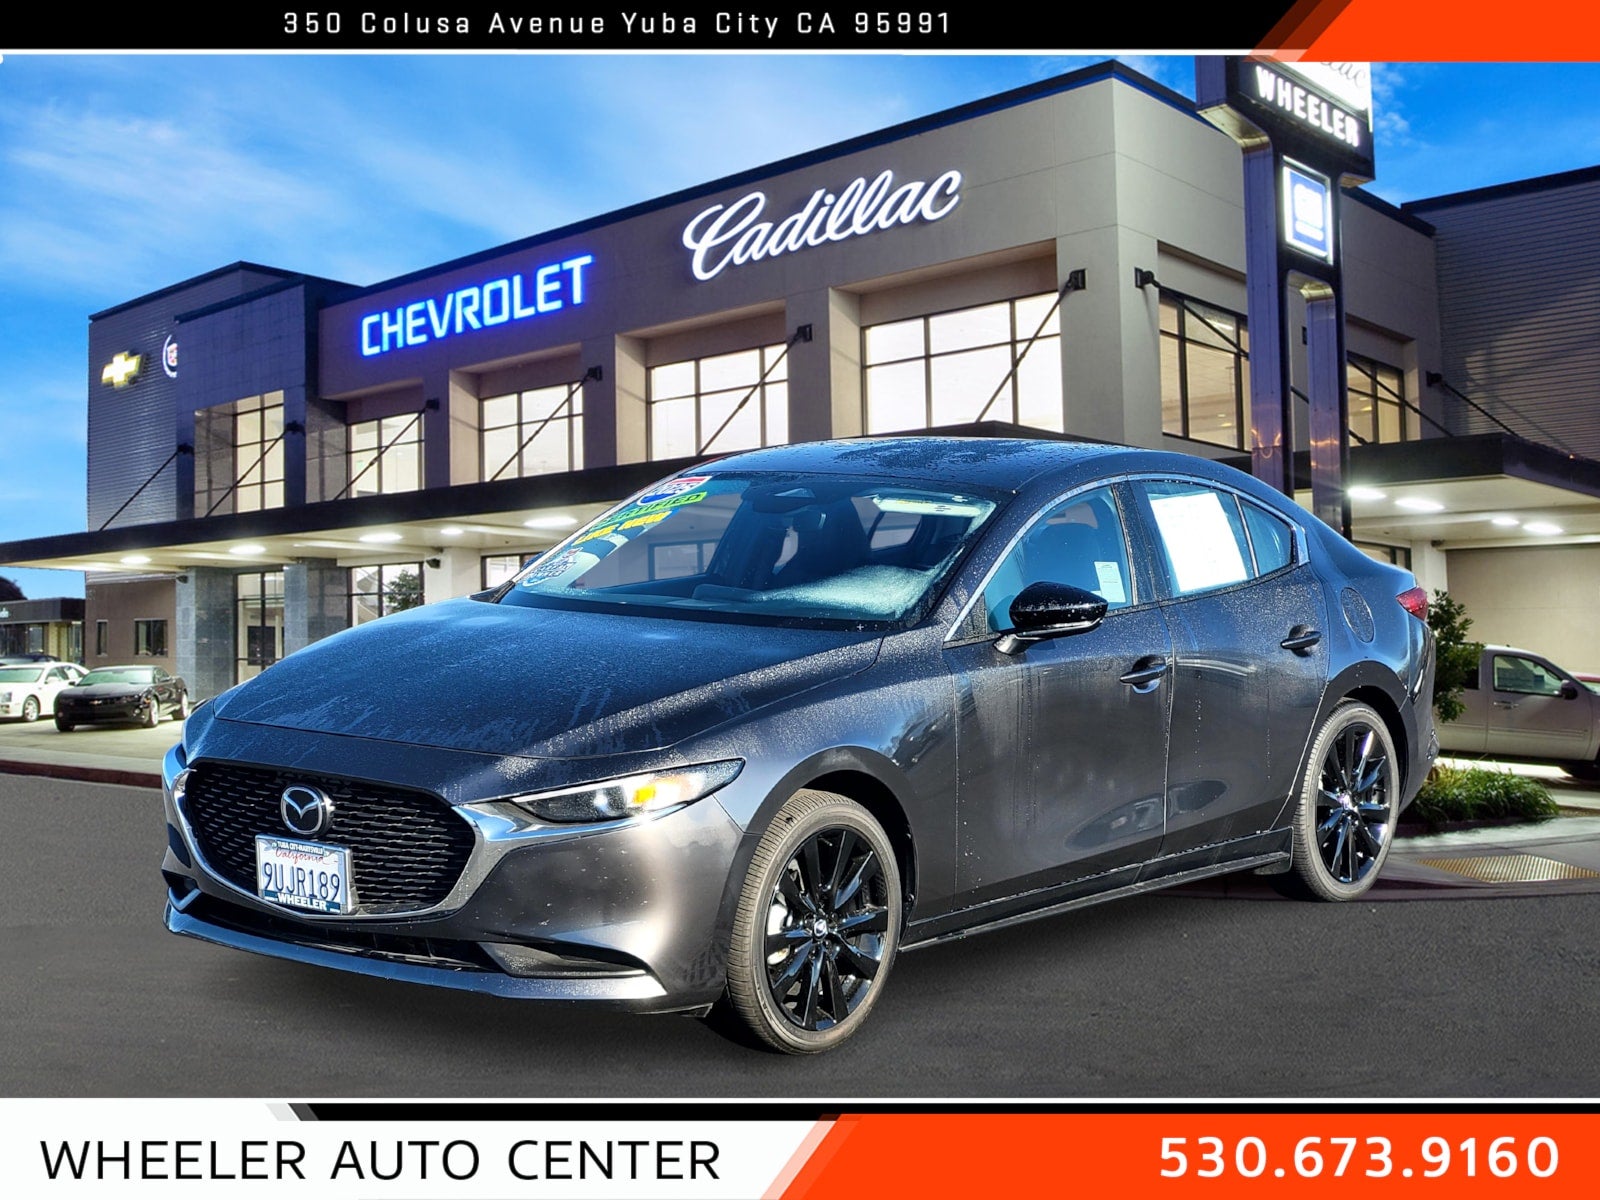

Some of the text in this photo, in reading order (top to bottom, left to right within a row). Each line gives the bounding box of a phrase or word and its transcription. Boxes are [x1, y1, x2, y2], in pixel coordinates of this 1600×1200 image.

[1255, 65, 1360, 148] WHEELER
[682, 169, 962, 281] Cadillac
[361, 254, 593, 357] CHEVROLET
[263, 862, 340, 902] 9UJR189
[276, 847, 328, 864] California
[277, 892, 328, 912] WHEELER
